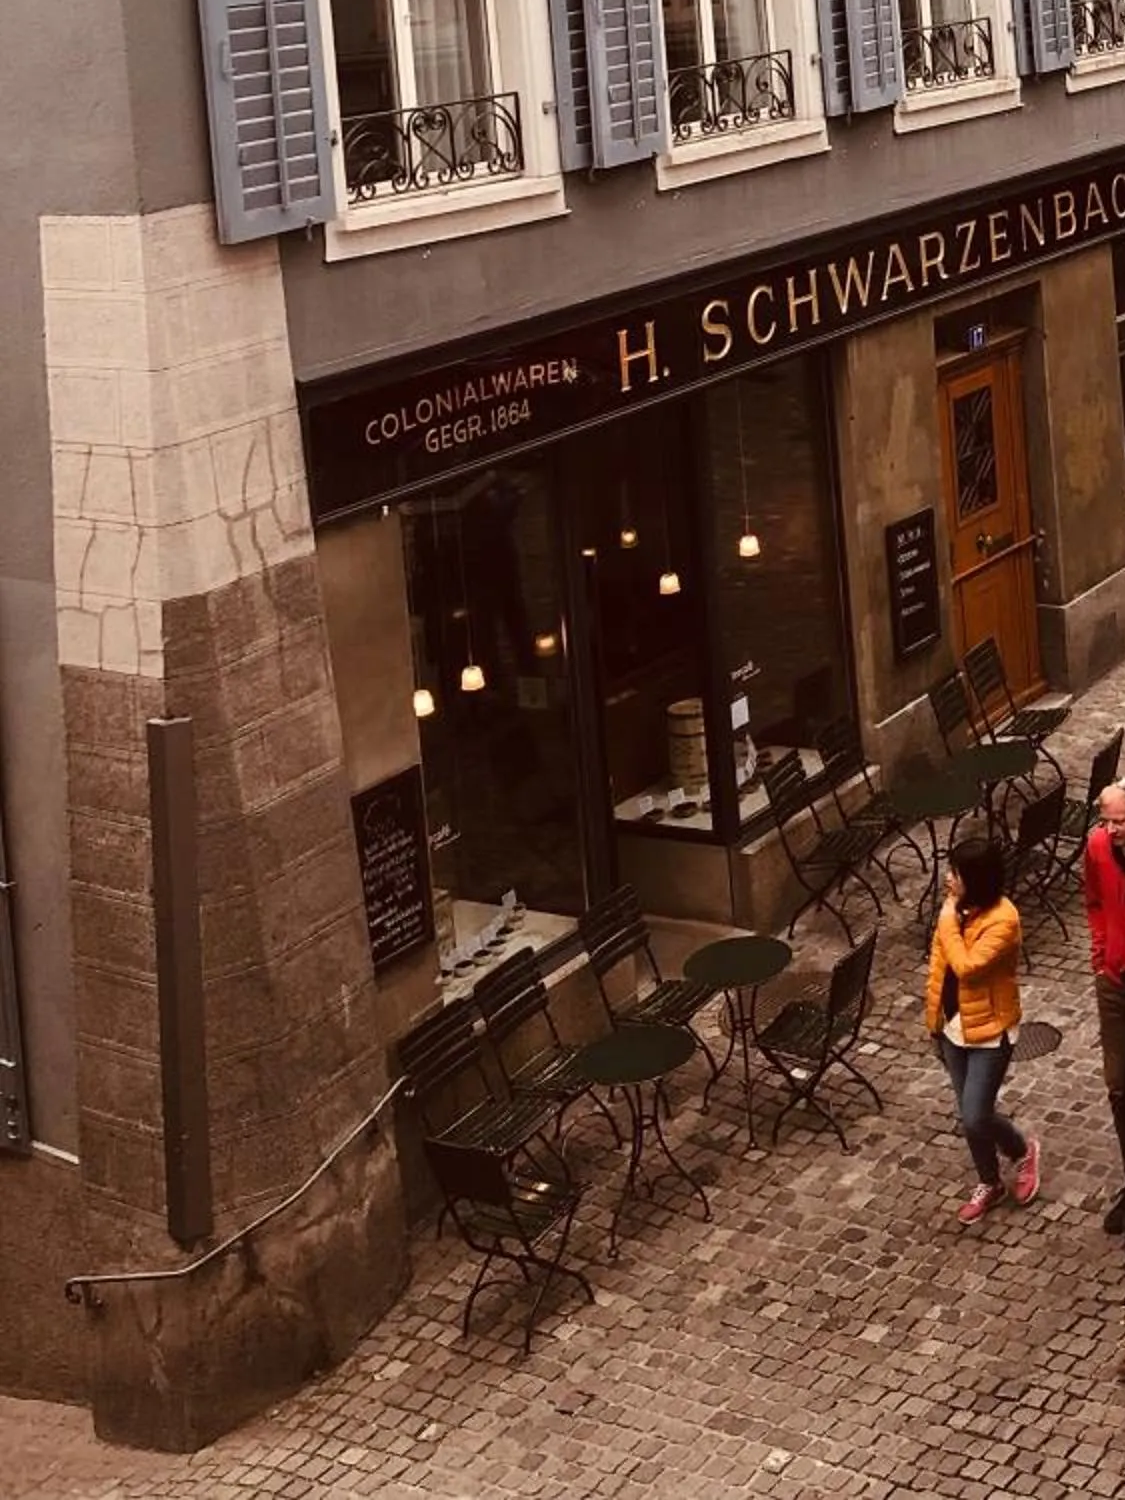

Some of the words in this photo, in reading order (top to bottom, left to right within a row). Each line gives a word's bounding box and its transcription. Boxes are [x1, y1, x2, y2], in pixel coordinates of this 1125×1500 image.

[616, 320, 671, 393] H.
[365, 357, 579, 445] COLONIALWAREN
[425, 414, 488, 454] GEGR.
